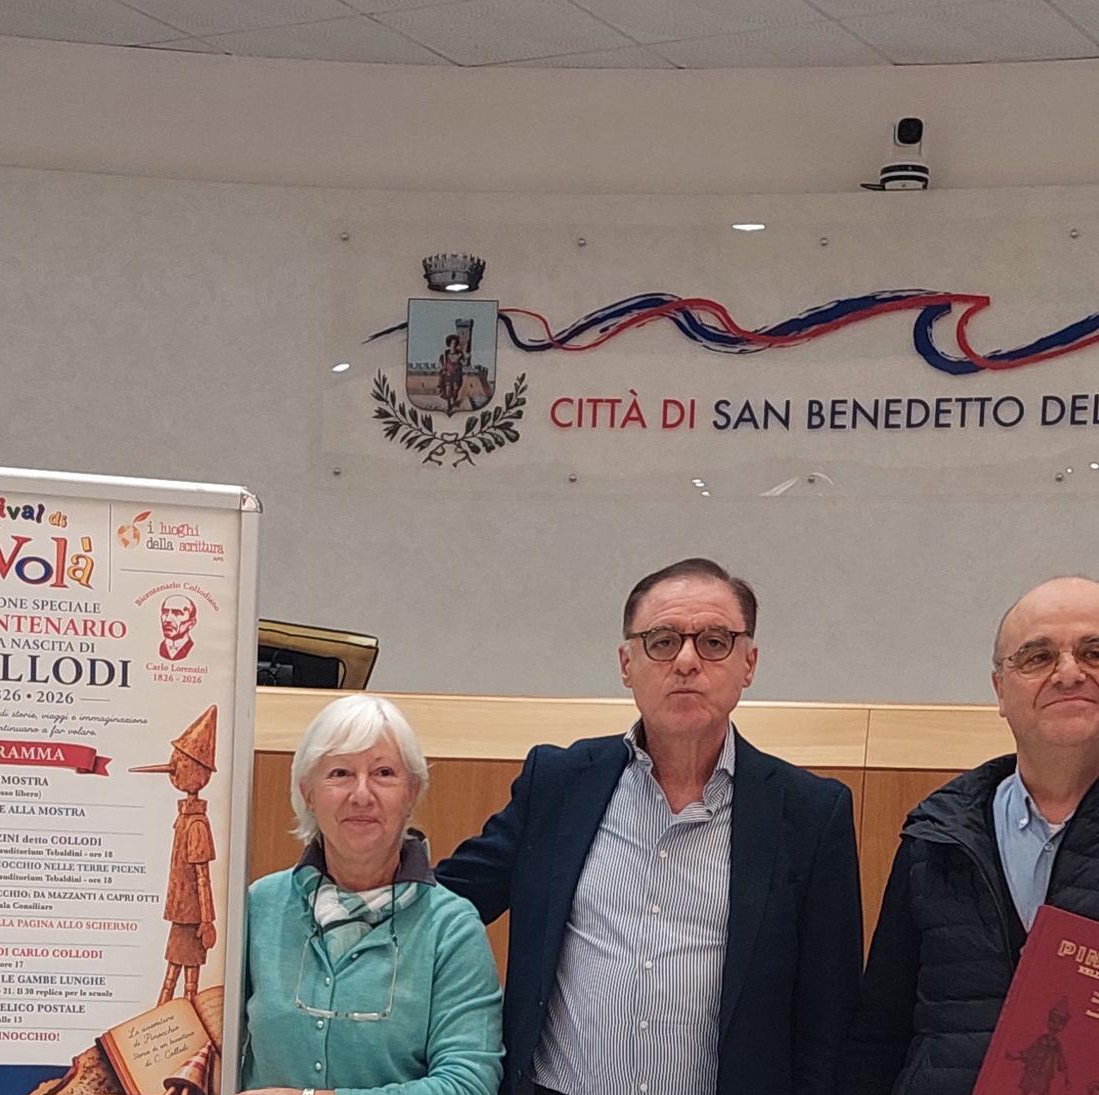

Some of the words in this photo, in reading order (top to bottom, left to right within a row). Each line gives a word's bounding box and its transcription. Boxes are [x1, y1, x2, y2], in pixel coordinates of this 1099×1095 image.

[550, 389, 647, 429] CITTÀ
[662, 398, 696, 429] DI
[712, 398, 790, 430] SAN
[807, 396, 1025, 431] BENEDETTO
[49, 511, 67, 528] di
[147, 521, 154, 534] i
[159, 522, 199, 538] luoghi
[146, 537, 174, 551] della
[179, 540, 224, 554] scrittura
[33, 599, 101, 614] SPECIALE
[10, 638, 74, 652] NASCITA
[79, 642, 95, 653] DI
[145, 662, 169, 672] Carlo
[171, 664, 208, 674] Lorenzini
[153, 674, 174, 682] 1826
[181, 675, 202, 684] 2026
[36, 690, 74, 704] 2026
[0, 708, 10, 717] di
[41, 711, 69, 723] viaggi
[79, 713, 148, 725] immaginazione
[50, 726, 66, 737] far
[1, 775, 49, 787] MOSTRA
[8, 804, 35, 815] ALLA
[38, 805, 86, 817] MOSTRA
[22, 834, 48, 845] detto
[51, 836, 102, 846] COLLODI
[46, 848, 83, 857] Tebaldini
[44, 862, 75, 871] NELLE
[77, 863, 109, 873] TERRE
[111, 864, 146, 874] PICENE
[45, 875, 82, 883] Tebaldini
[33, 890, 46, 899] DA
[48, 891, 97, 901] MAZZANTI
[98, 893, 105, 901] A
[17, 919, 54, 929] PAGINA
[56, 920, 83, 930] ALLO
[85, 921, 138, 931] SCHERMO
[11, 948, 49, 958] CARLO
[52, 949, 103, 959] COLLODI
[1, 974, 15, 984] LE
[17, 975, 57, 985] GAMBE
[59, 976, 106, 986] LUNGHE
[37, 1004, 85, 1014] POSTALE
